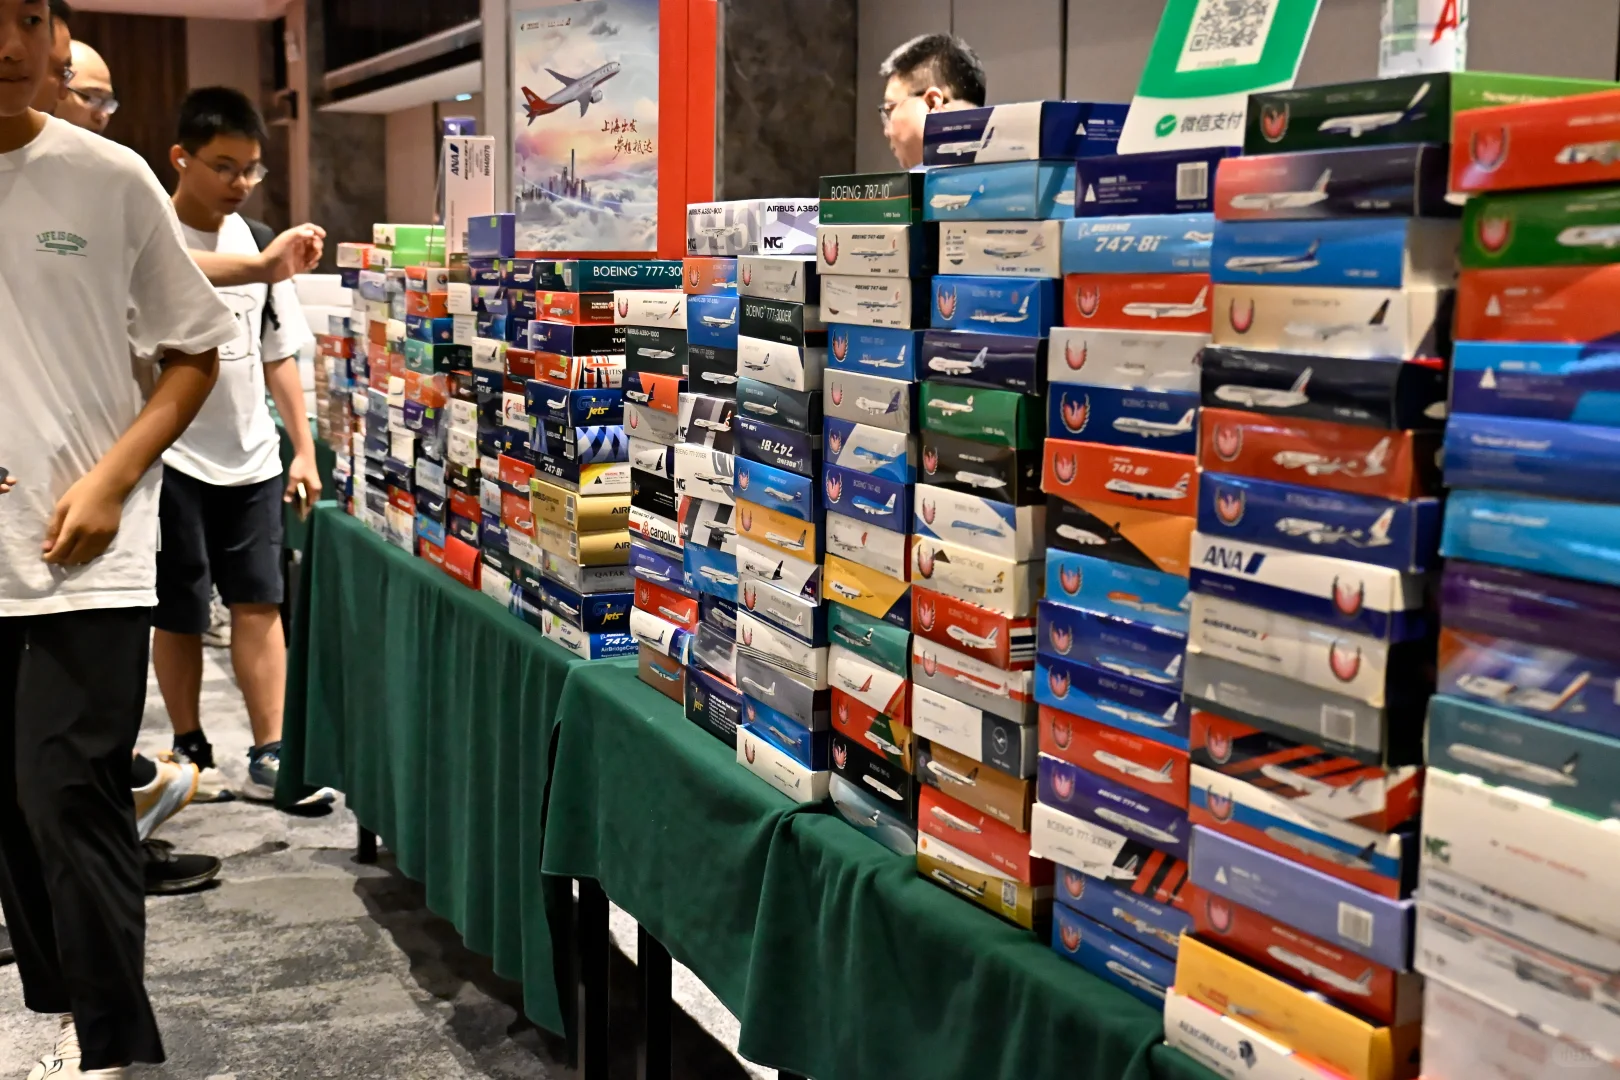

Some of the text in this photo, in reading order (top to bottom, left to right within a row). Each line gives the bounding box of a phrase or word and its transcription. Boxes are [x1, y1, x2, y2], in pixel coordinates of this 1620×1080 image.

[1180, 111, 1244, 133] 微信支付
[450, 154, 460, 176] ANA
[831, 184, 890, 200] BOEING 787-10
[35, 231, 56, 244] LIFE
[57, 231, 66, 241] IS
[764, 236, 784, 249] NG
[776, 457, 797, 468] BOEING
[675, 477, 686, 490] NG
[650, 526, 677, 545] cargolux
[679, 522, 689, 536] NG
[1203, 545, 1243, 570] ANA
[594, 569, 626, 578] QATAR
[684, 571, 694, 586] NG
[1046, 819, 1074, 837] BOEING
